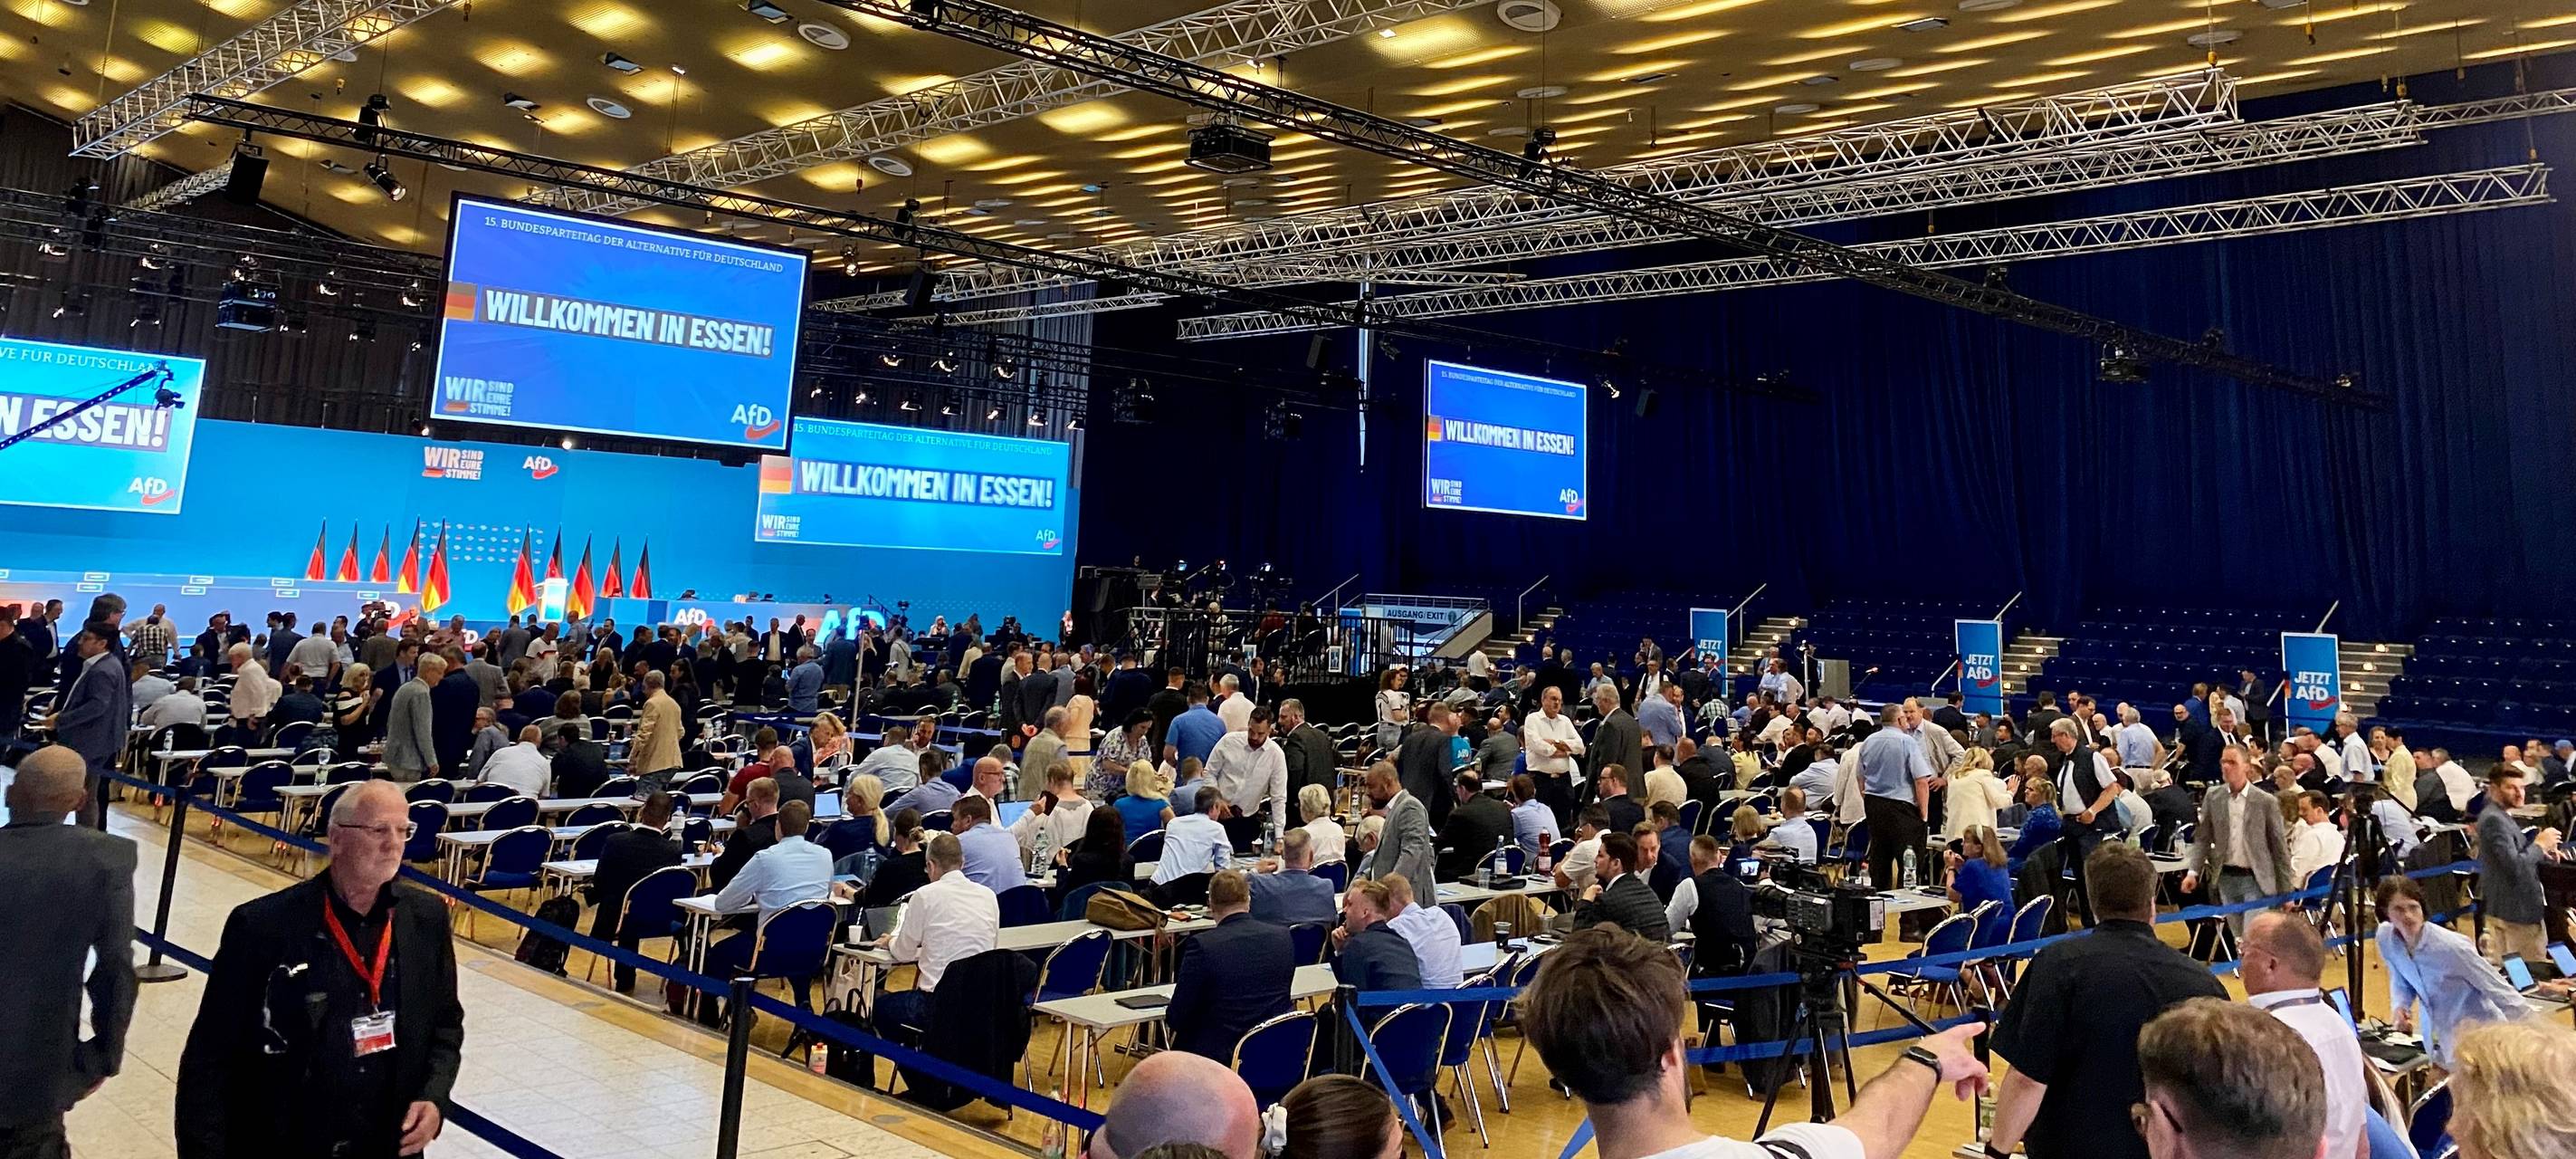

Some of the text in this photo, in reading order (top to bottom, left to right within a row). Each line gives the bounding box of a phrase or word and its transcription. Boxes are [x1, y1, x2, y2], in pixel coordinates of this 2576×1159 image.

[485, 216, 784, 273] 15. BUNDESPARTEITAG DER ALTERNATIVE FÜR DEUTSCHLAND
[485, 290, 773, 356] WILLKOMMEN IN ESSEN!
[21, 348, 52, 363] FÜR
[445, 377, 514, 402] WIR SIND
[486, 392, 512, 406] EURE
[470, 402, 511, 417] STIMME!
[730, 404, 772, 427] AfD
[30, 398, 167, 447] ESSEN!
[807, 424, 894, 441] BUNDESPARTEITAG
[896, 433, 912, 443] DER
[915, 435, 972, 449] ALTERNATIVE
[992, 442, 1052, 455] DEUTSCHLAND
[1445, 419, 1575, 455] WILLKOMMEN IN ESSEN!
[424, 446, 484, 469] WIR SIND
[522, 455, 552, 471] AfD
[445, 469, 482, 480] STIMME!
[128, 476, 167, 495] AfD
[801, 461, 1053, 508] WILLKOMMEN IN ESSEN!
[1431, 478, 1450, 494] WIR
[1560, 488, 1579, 503] AfD
[762, 514, 786, 529] WIR
[1035, 529, 1055, 541] AfD
[673, 608, 707, 626] AfD
[1698, 638, 1722, 650] JETZT
[1966, 654, 1995, 666] JETZT
[1966, 666, 1992, 680] AfD
[2295, 672, 2332, 685] JETZT
[2295, 685, 2329, 701] AfD
